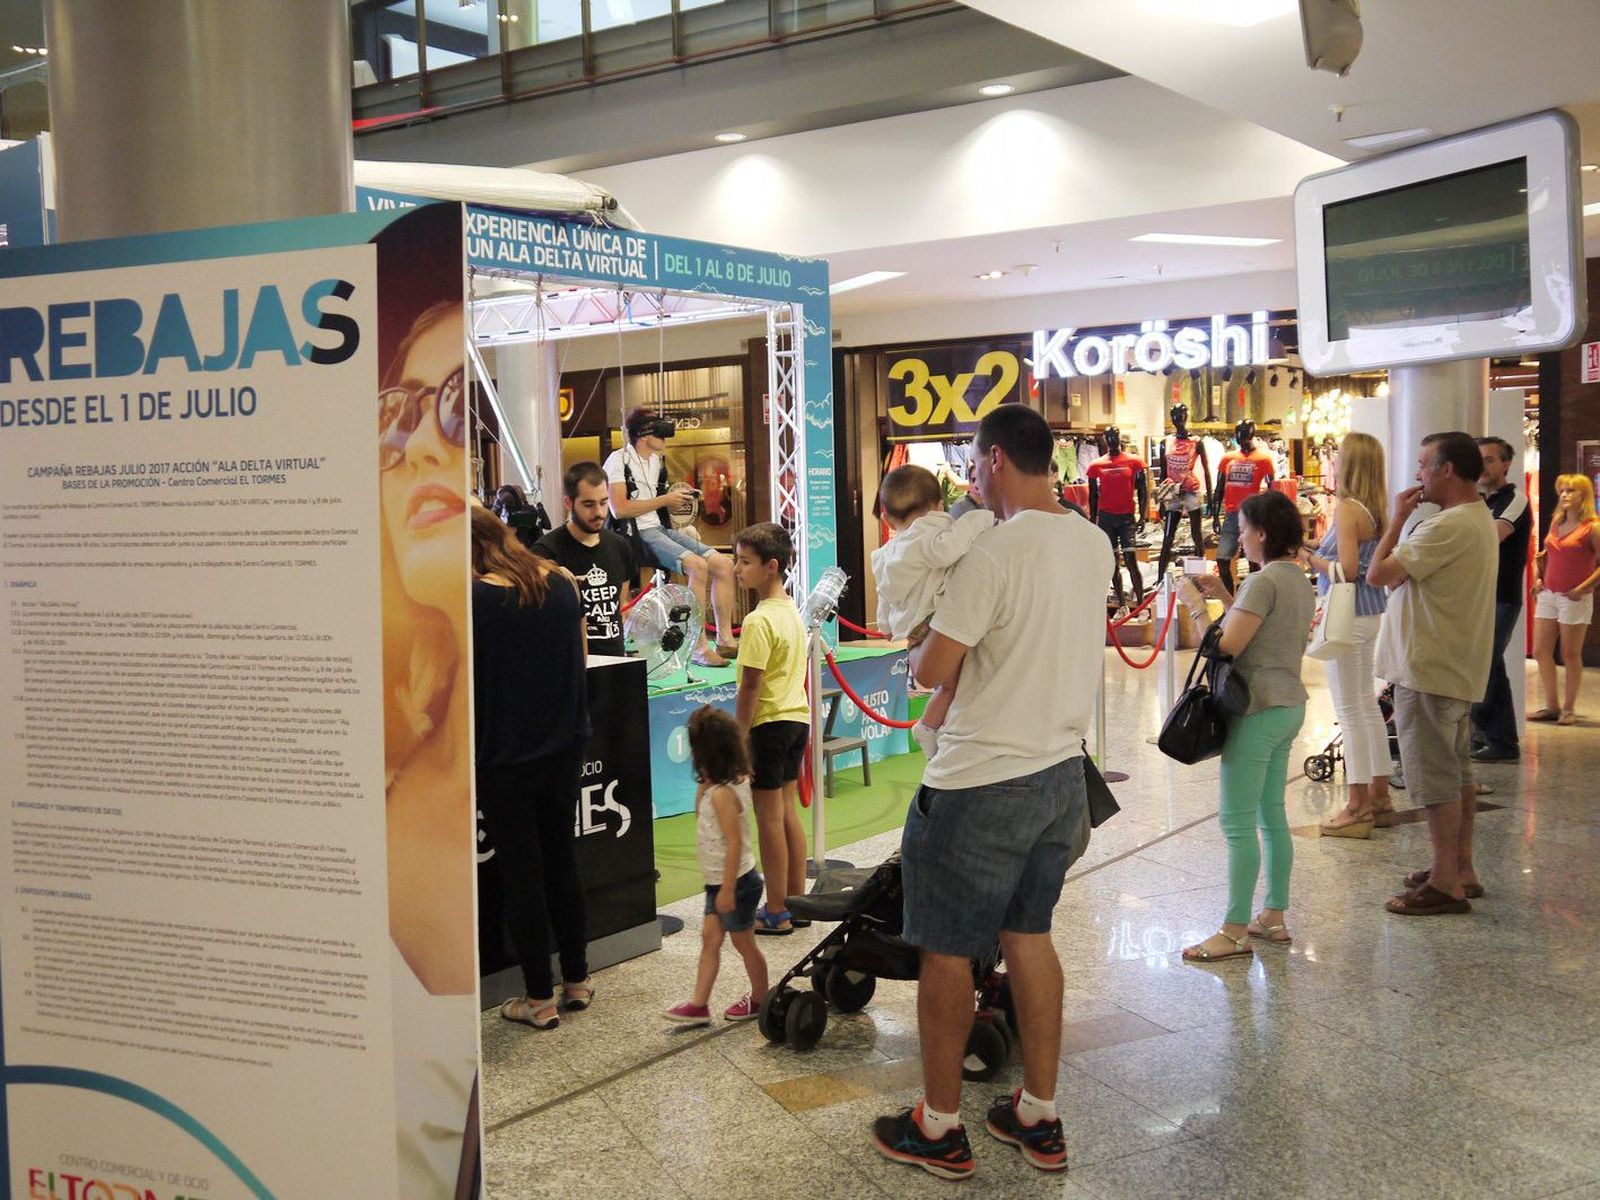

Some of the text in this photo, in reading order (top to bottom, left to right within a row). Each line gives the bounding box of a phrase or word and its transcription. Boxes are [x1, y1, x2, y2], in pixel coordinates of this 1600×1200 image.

[465, 212, 648, 259] XPERIENCIA ÚNICA DE
[467, 236, 648, 280] UN ALA DELTA VIRTUAL
[664, 253, 791, 287] DEL 1 AL 8 DE JULIO
[0, 279, 360, 384] REBAJAS
[1032, 309, 1270, 380] Koröshi
[1, 386, 257, 427] DESDE EL 1 DE JULIO
[887, 351, 1020, 427] 3x2
[27, 463, 73, 478] CAMPAÑA
[75, 464, 117, 477] REBAJAS
[119, 463, 147, 475] JULIO
[149, 462, 170, 474] 2017
[172, 458, 210, 474] ACCIÓN
[240, 458, 273, 472] DELTA
[62, 479, 87, 490] BASES
[87, 479, 99, 489] DE
[100, 479, 110, 489] LA
[112, 477, 160, 489] PROMOCIÓN
[168, 477, 195, 487] Centro
[196, 475, 238, 487] Comercial
[240, 475, 250, 485] EL
[251, 474, 287, 485] TORMES
[581, 585, 618, 602] KEEP
[676, 733, 683, 755] 1
[59, 1153, 99, 1172] CENTRO
[100, 1157, 156, 1182] COMERCIAL
[167, 1171, 182, 1186] DE
[183, 1174, 210, 1191] OCIO
